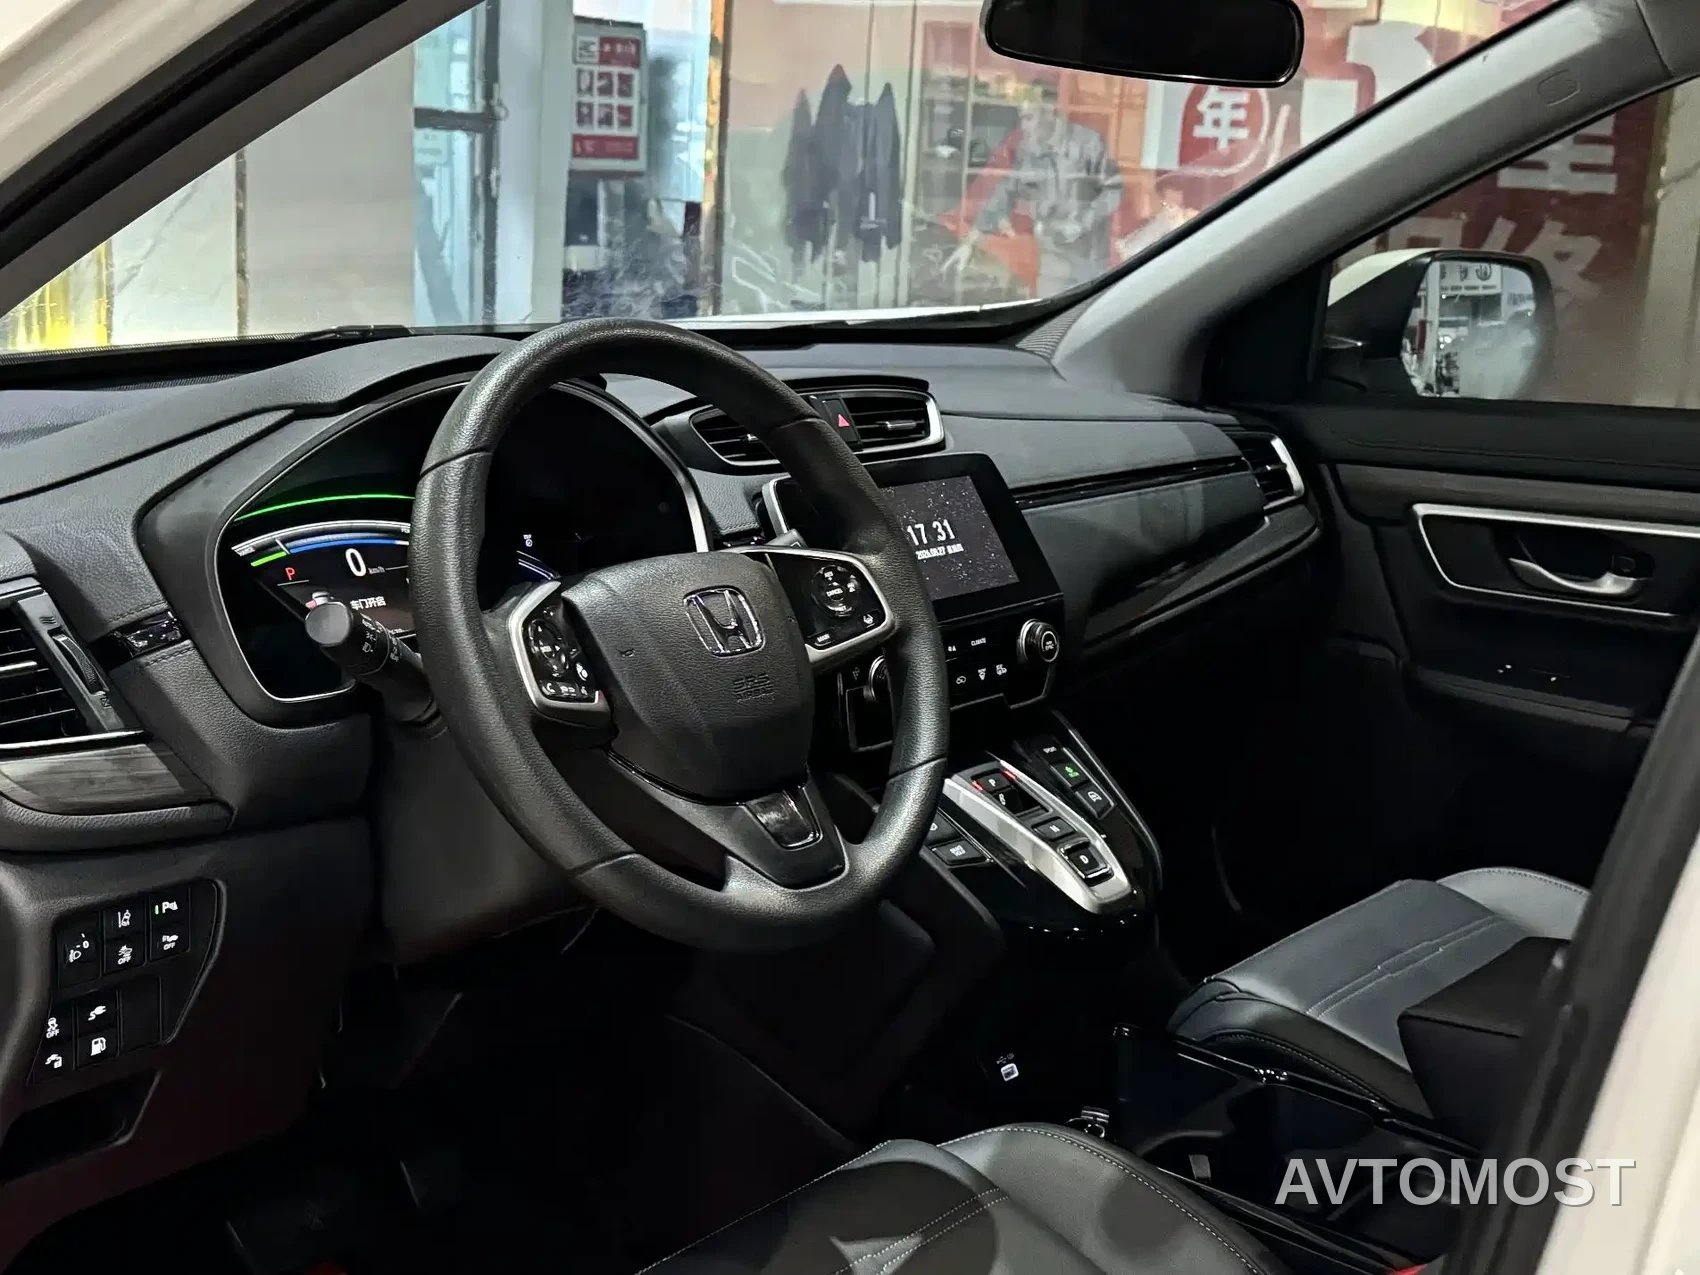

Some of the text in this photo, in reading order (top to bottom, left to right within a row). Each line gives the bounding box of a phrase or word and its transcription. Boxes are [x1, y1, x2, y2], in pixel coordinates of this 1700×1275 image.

[1193, 87, 1249, 154] 年
[906, 518, 955, 546] 17 31
[345, 548, 385, 577] 0 km/h
[285, 567, 296, 581] P
[350, 596, 387, 611] 车门开启
[1079, 854, 1089, 864] D
[164, 942, 176, 950] OFF
[117, 955, 132, 965] OFF
[46, 1028, 60, 1039] OFF
